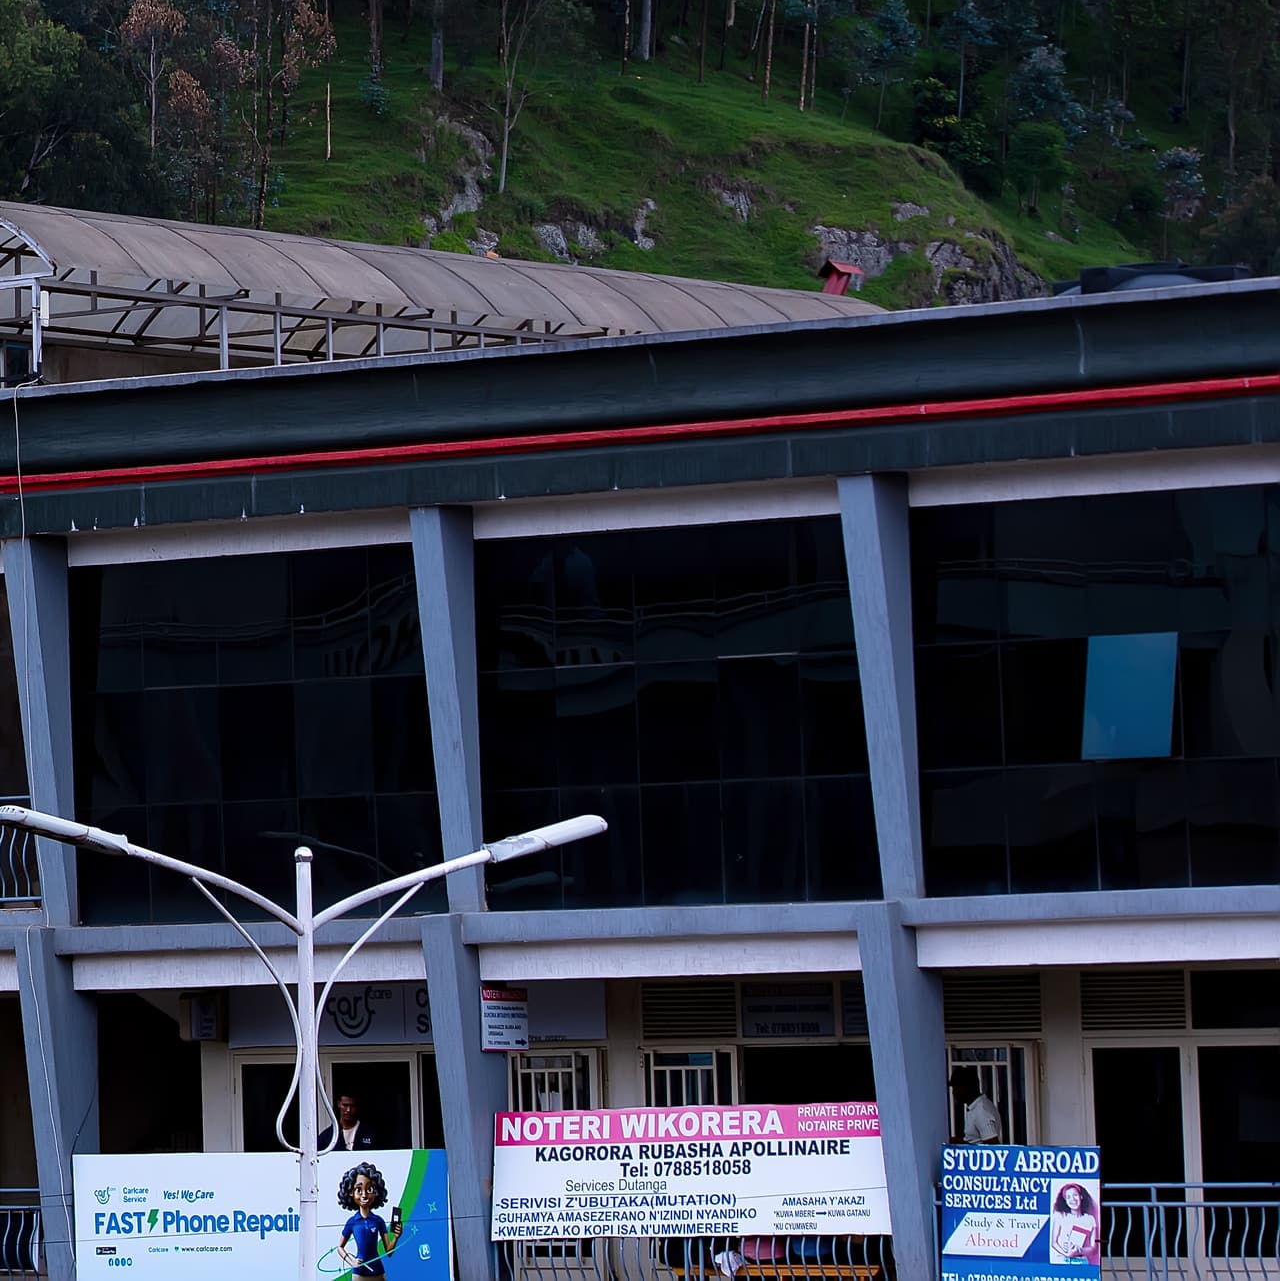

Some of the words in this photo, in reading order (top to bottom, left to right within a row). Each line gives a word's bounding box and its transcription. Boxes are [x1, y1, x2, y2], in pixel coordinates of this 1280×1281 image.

[797, 1105, 839, 1118] PRIVATE
[840, 1104, 879, 1116] NOTARY
[501, 1115, 610, 1142] NOTERI
[620, 1109, 784, 1139] WIKORERA
[798, 1120, 845, 1132] NOTAIRE
[847, 1118, 879, 1131] PRIVE
[535, 1145, 633, 1162] KAGORORA
[639, 1142, 724, 1160] RUBASHA
[729, 1139, 850, 1157] APOLLINAIRE
[943, 1148, 1009, 1171] STUDY
[1014, 1150, 1100, 1173] ABROAD
[620, 1162, 648, 1178] Tel:
[653, 1159, 751, 1177] 0788518058
[123, 1187, 149, 1195] Carlcare
[565, 1179, 615, 1192] Services
[618, 1178, 667, 1193] Dutanga
[943, 1175, 1051, 1193] CONSULTANCY
[163, 1190, 179, 1200] Yes!
[181, 1190, 194, 1199] We
[195, 1189, 214, 1199] Care
[495, 1197, 561, 1209] -SERIVISI
[565, 1193, 737, 1209] Z'UBUTAKA(MUTATION)
[782, 1196, 827, 1206] AMASAHA
[945, 1193, 1012, 1209] SERVICES
[1015, 1195, 1038, 1210] Ltd
[494, 1212, 555, 1223] -GUHAMYA
[557, 1211, 646, 1223] AMASEZERANO
[649, 1209, 693, 1221] N'IZINDI
[696, 1208, 757, 1220] NYANDIKO
[794, 1209, 816, 1218] MBERE
[827, 1209, 846, 1217] KUWA
[846, 1209, 871, 1217] GATANU
[94, 1211, 146, 1235] FAST
[163, 1210, 230, 1233] Phone
[233, 1207, 300, 1240] Repair
[494, 1225, 559, 1237] -KWEMEZA
[562, 1225, 581, 1236] KO
[584, 1224, 613, 1236] KOPI
[617, 1224, 637, 1235] ISA
[640, 1222, 739, 1235] N'UMWIMERERE
[964, 1217, 993, 1232] Study
[996, 1218, 1005, 1228] &
[1008, 1218, 1040, 1230] Travel
[964, 1233, 1019, 1248] Abroad
